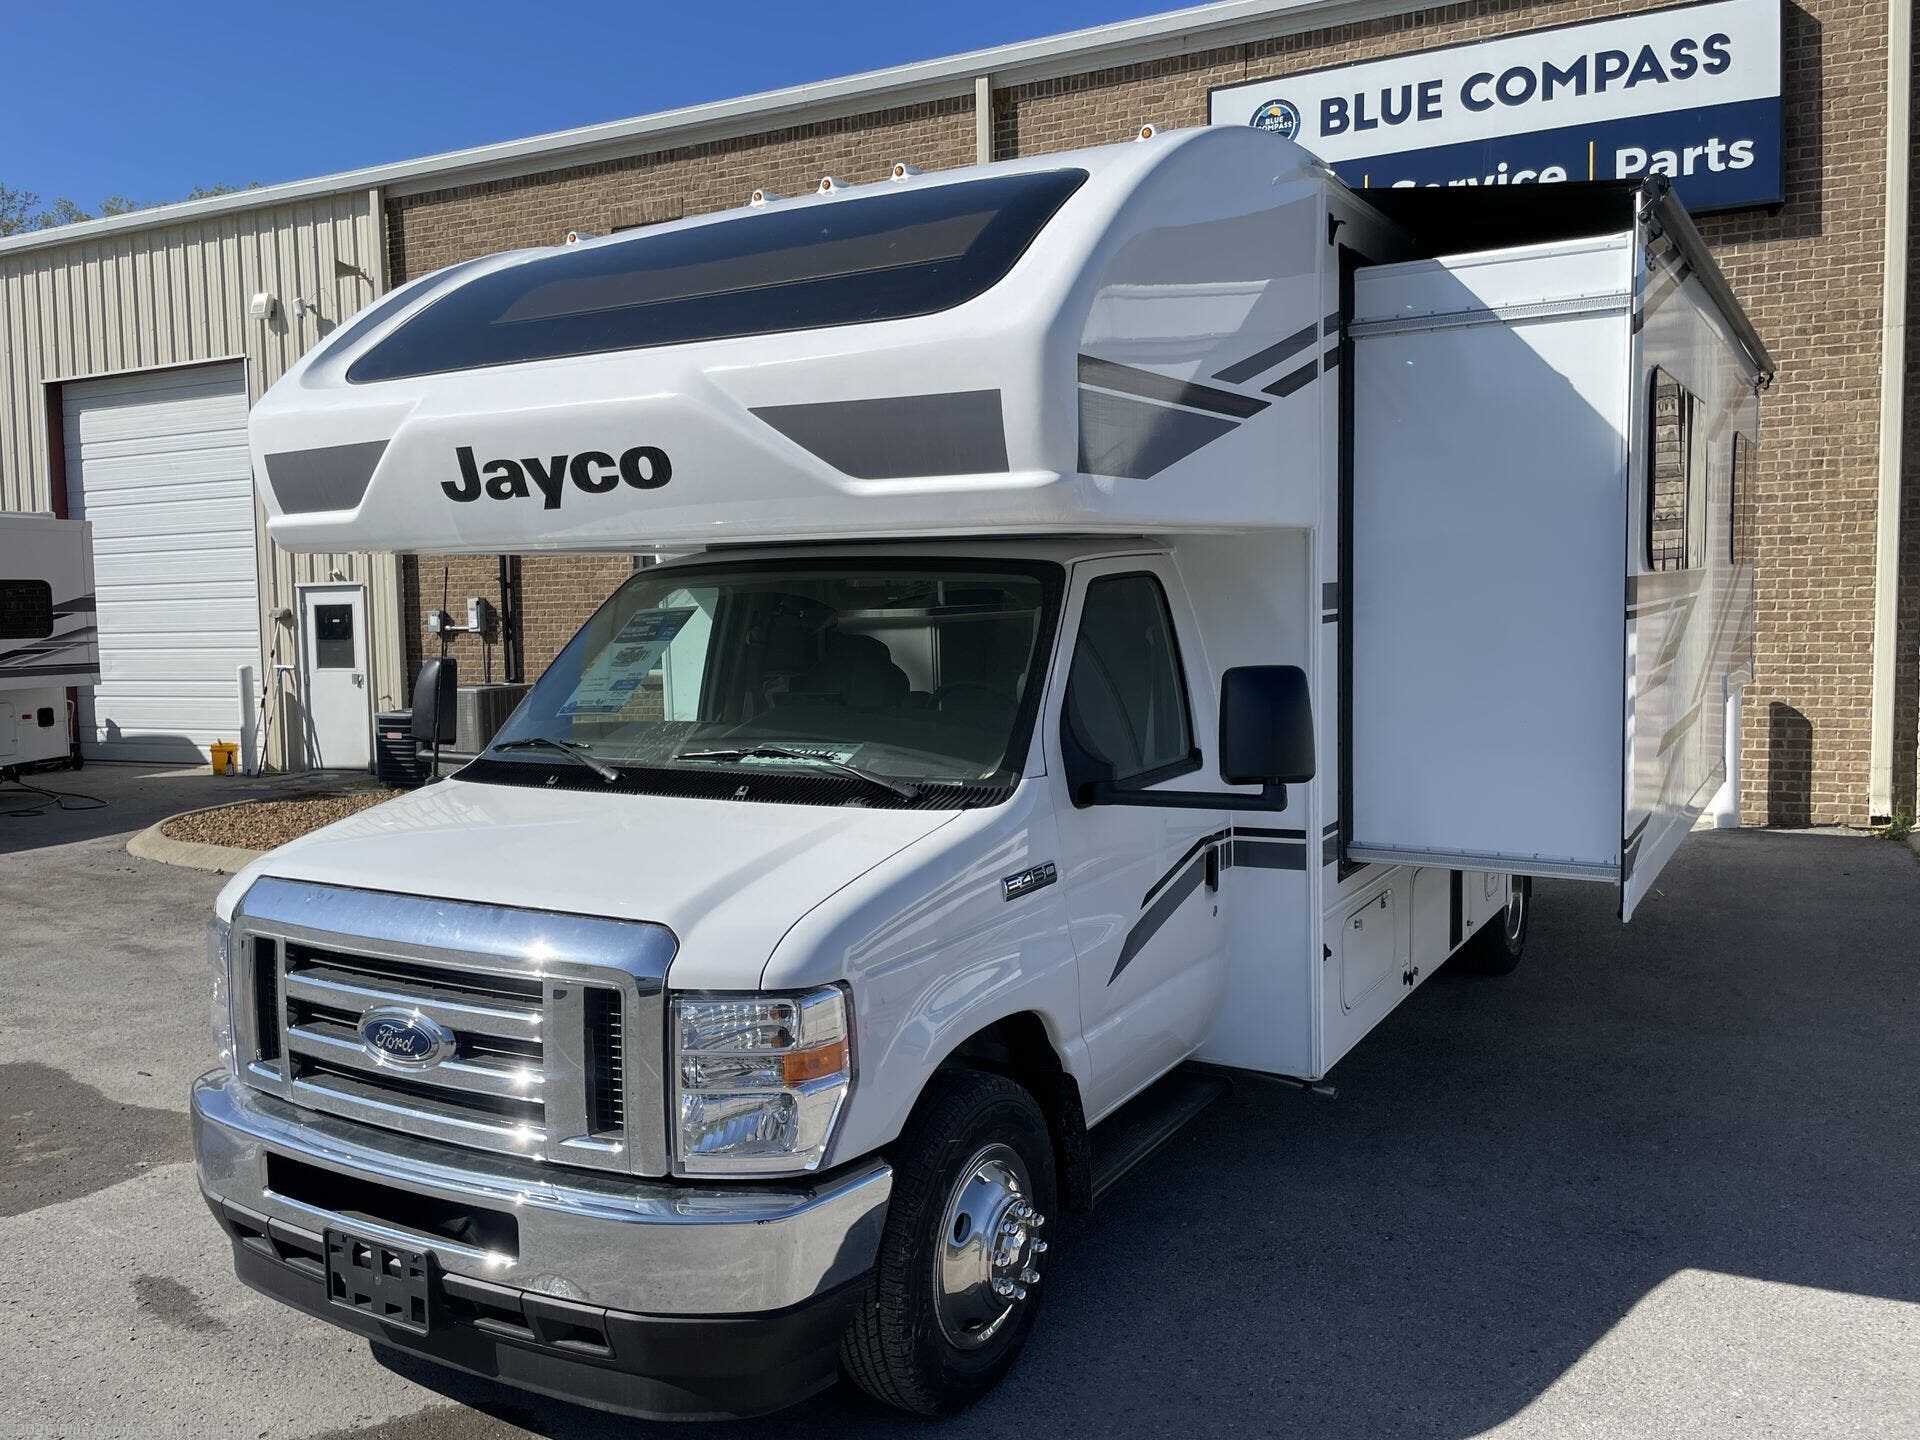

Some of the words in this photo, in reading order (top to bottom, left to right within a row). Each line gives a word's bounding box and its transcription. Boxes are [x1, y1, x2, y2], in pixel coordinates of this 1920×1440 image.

[1320, 79, 1443, 138] BLUE
[1460, 32, 1732, 112] COMPASS
[1258, 120, 1293, 131] OMPASS
[1265, 116, 1284, 125] BLUE
[1615, 136, 1755, 181] Parts
[440, 445, 673, 510] Jayco
[375, 1024, 415, 1052] Ford
